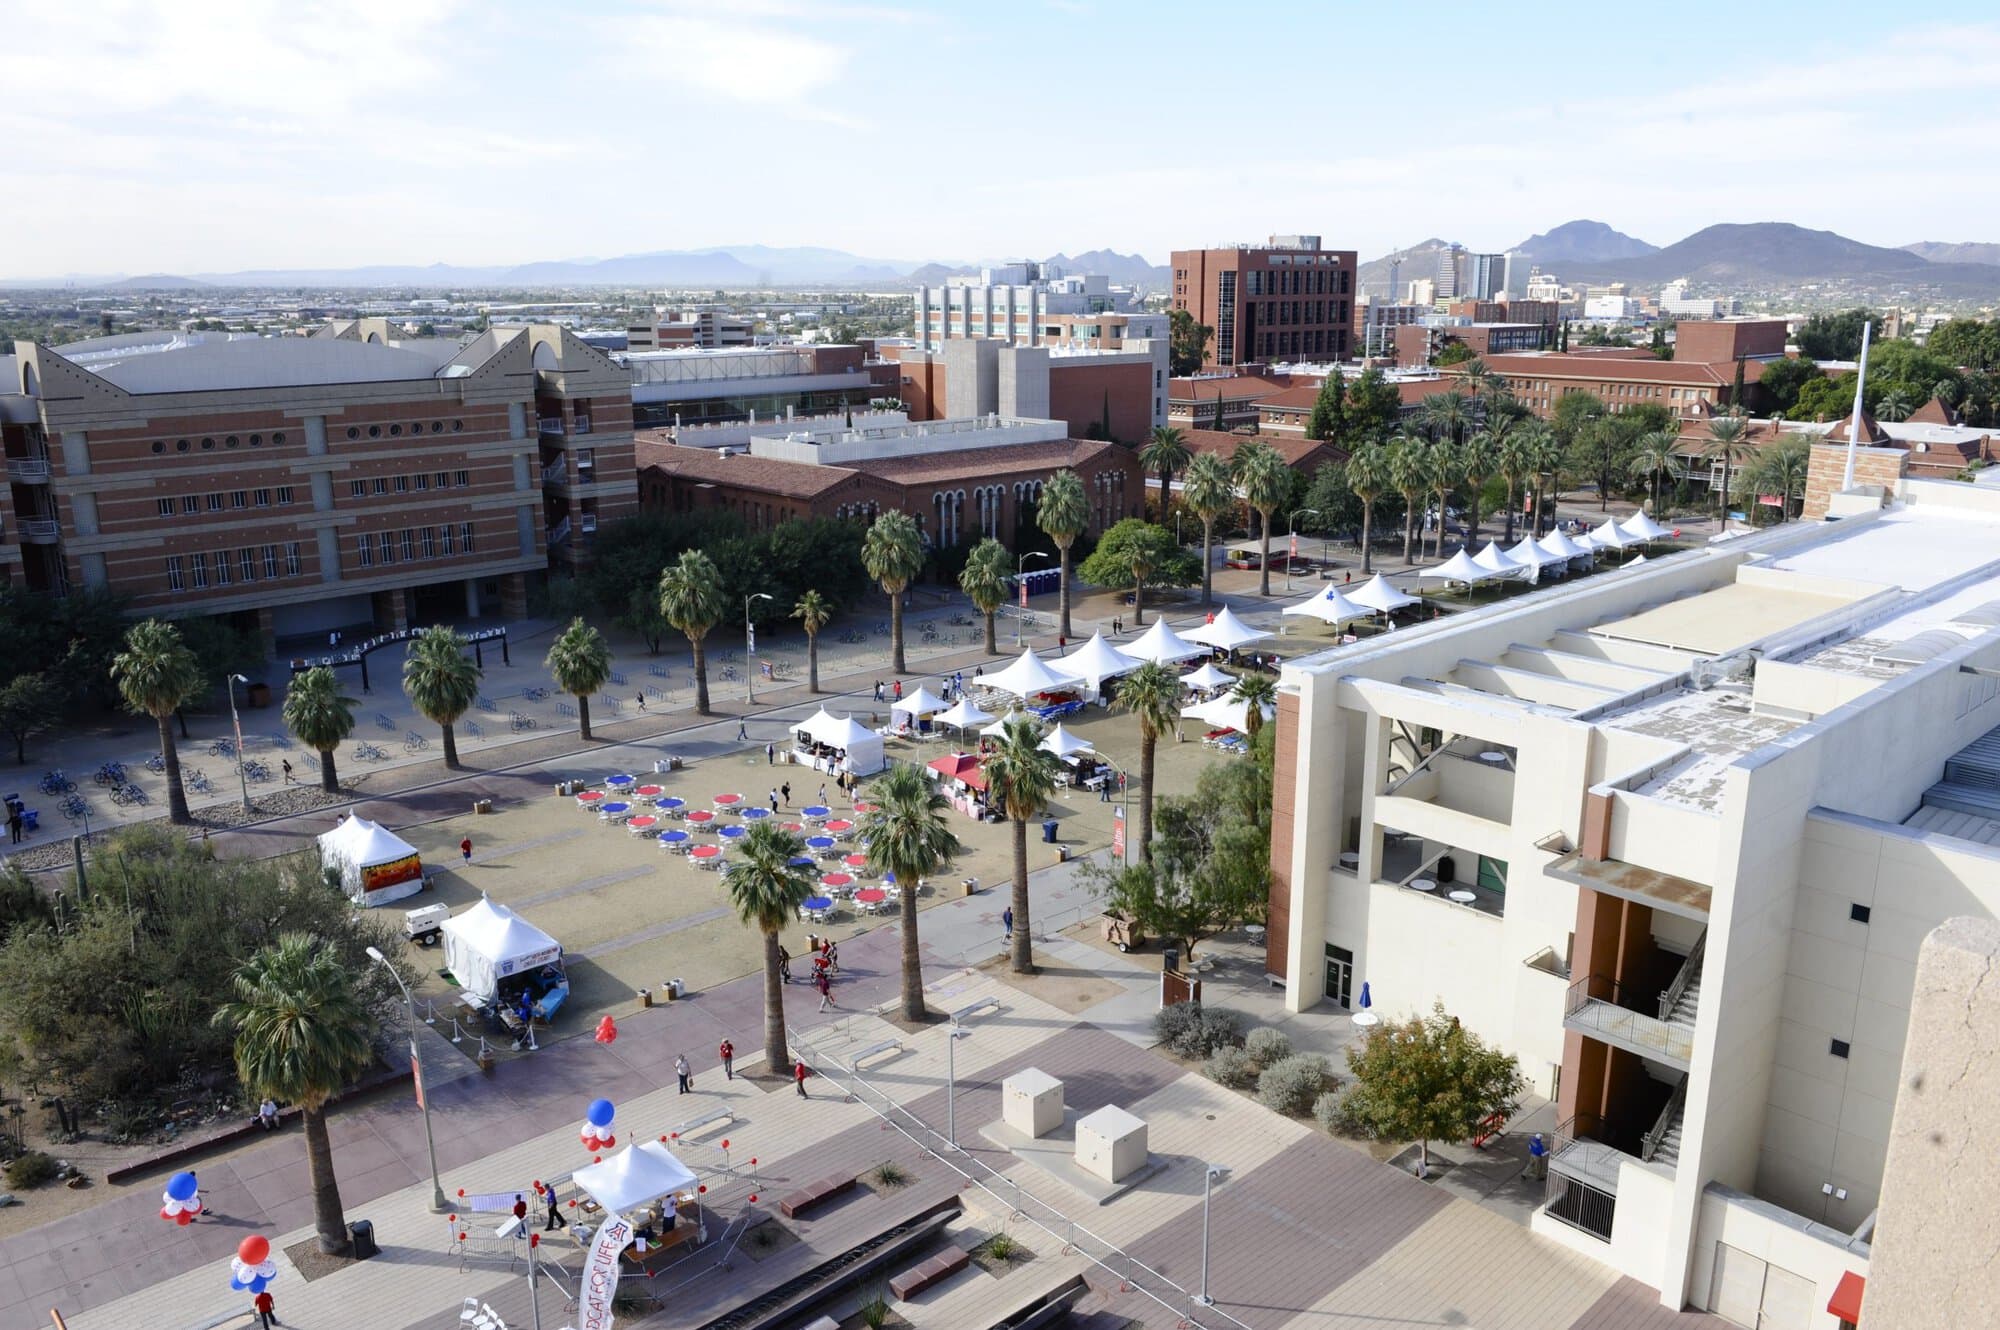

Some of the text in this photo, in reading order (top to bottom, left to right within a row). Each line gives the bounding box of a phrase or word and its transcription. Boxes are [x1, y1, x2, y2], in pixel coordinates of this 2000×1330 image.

[605, 1222, 628, 1242] A
[594, 1240, 615, 1265] LIFE
[590, 1265, 608, 1294] FOR
